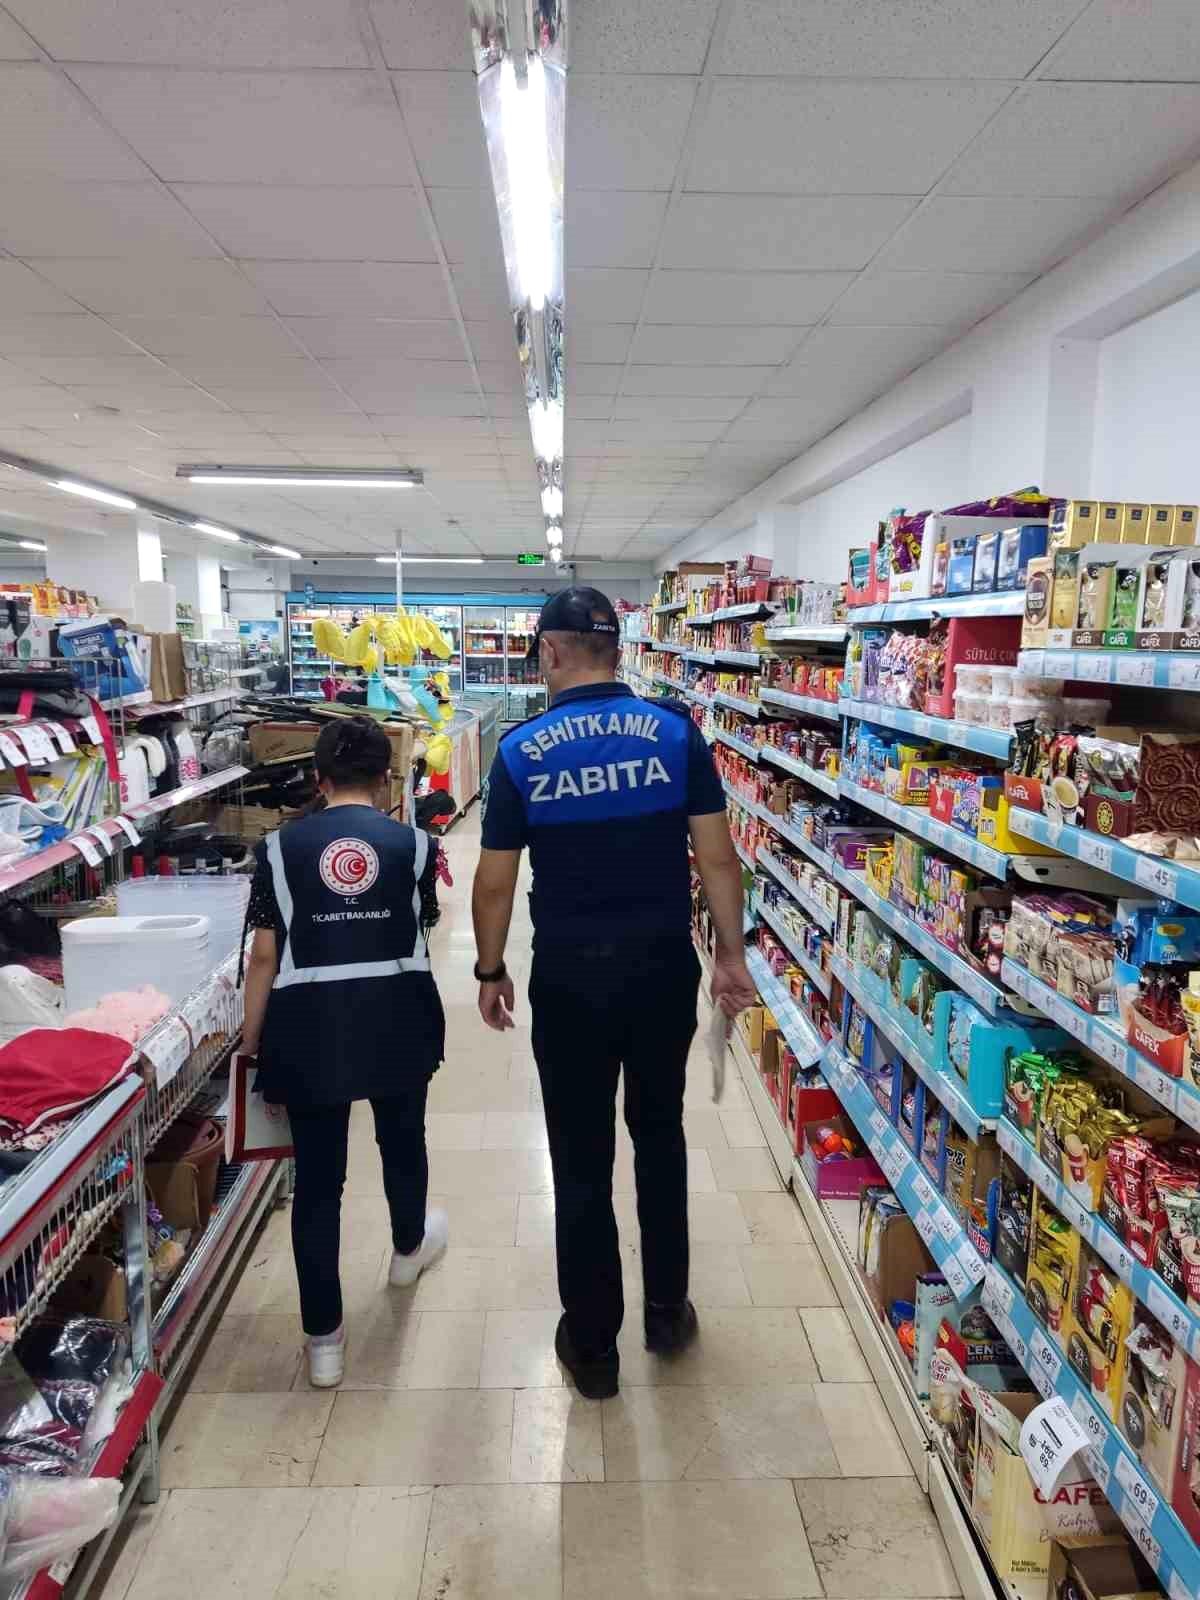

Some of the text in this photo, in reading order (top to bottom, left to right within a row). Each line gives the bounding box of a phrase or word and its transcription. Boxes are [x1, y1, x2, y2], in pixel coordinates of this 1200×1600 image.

[1141, 634, 1161, 647] CAFEX
[520, 712, 661, 762] ŞEHİTKAMİL
[527, 756, 672, 803] ZABITA
[1154, 868, 1169, 886] 45
[344, 897, 359, 905] T.C.
[1134, 1028, 1160, 1057] CAFEX
[1041, 1347, 1053, 1365] 69
[1088, 1415, 1101, 1435] 69
[1133, 1482, 1148, 1504] 69
